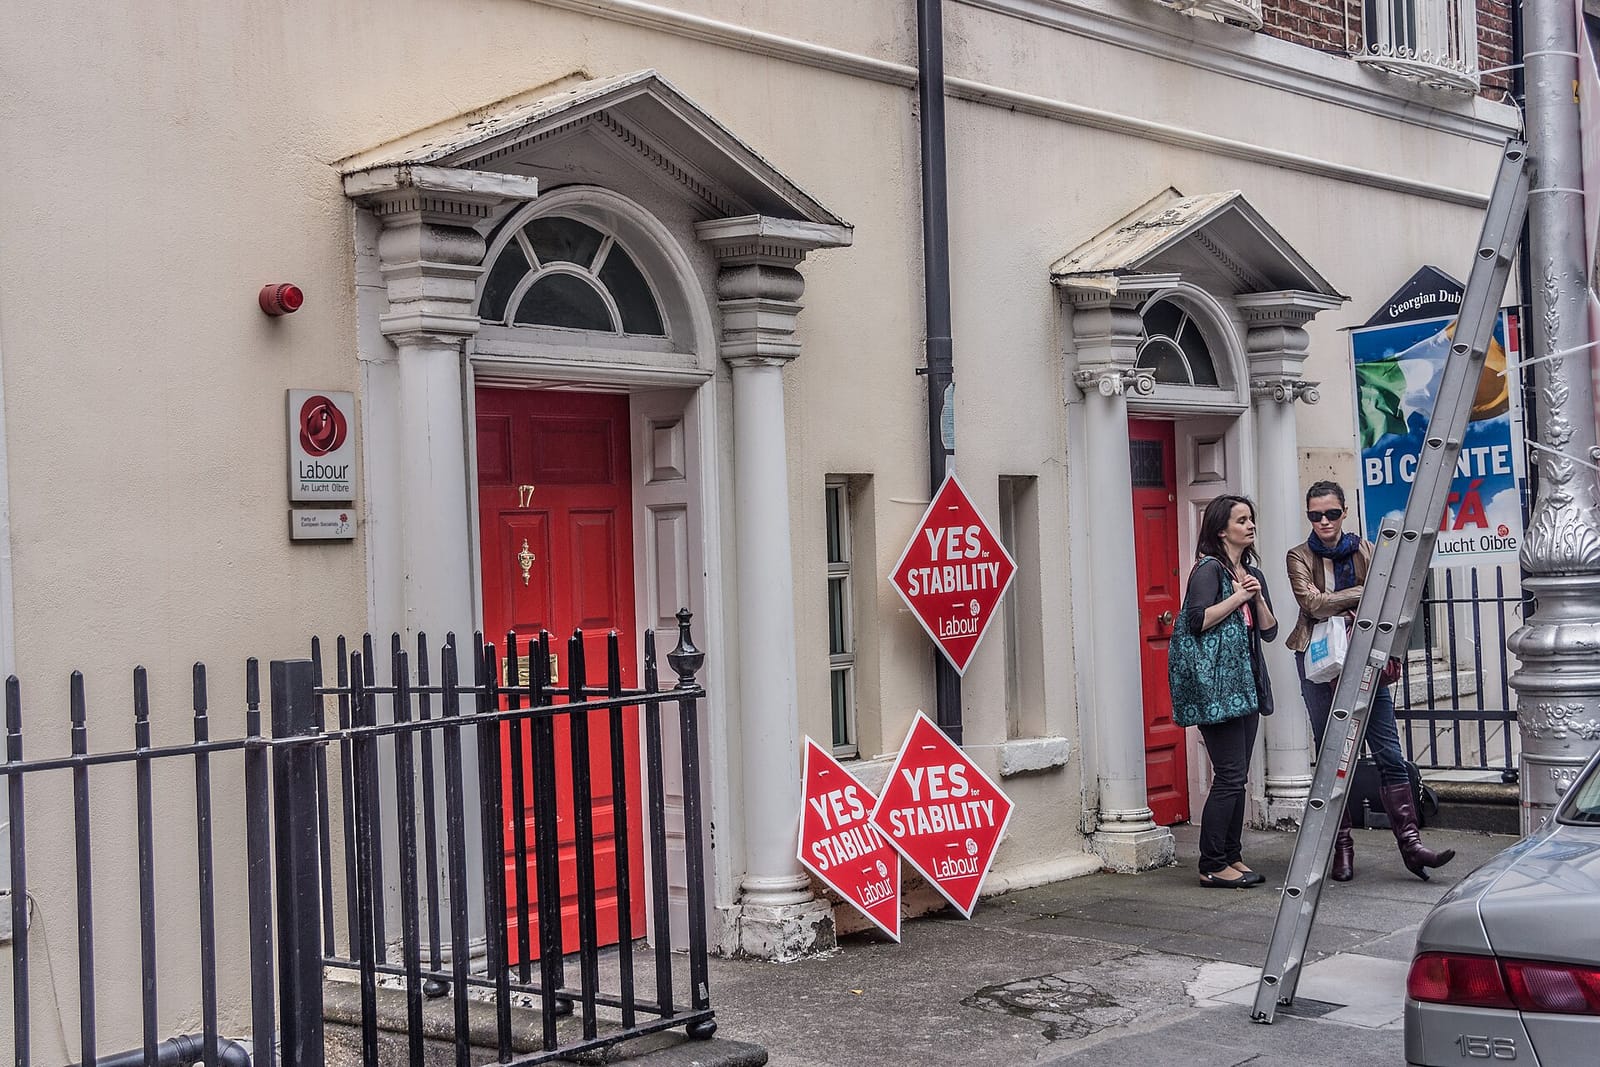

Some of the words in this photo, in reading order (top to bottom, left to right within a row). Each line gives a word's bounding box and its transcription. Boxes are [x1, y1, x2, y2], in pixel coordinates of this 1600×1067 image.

[1389, 292, 1436, 318] Georgian
[1439, 289, 1462, 304] Dub
[299, 460, 349, 479] Labour
[1365, 448, 1394, 486] BÍ
[1399, 444, 1511, 483] CNTE
[300, 484, 310, 492] An
[311, 484, 330, 492] Lucht
[331, 484, 350, 493] Oibre
[518, 485, 535, 508] 17
[925, 525, 981, 561] YES
[981, 550, 990, 558] for
[1437, 537, 1475, 554] Lucht
[1480, 535, 1517, 551] Oibre
[907, 562, 1000, 597] STABILITY
[939, 615, 979, 637] Labour
[901, 763, 969, 802] YES
[971, 788, 980, 796] for
[809, 785, 864, 831] YES
[889, 800, 995, 838] STABILITY
[812, 822, 884, 871] STABILIT
[932, 856, 979, 878] Labour
[856, 877, 894, 906] Labour
[1455, 1034, 1517, 1061] 156
